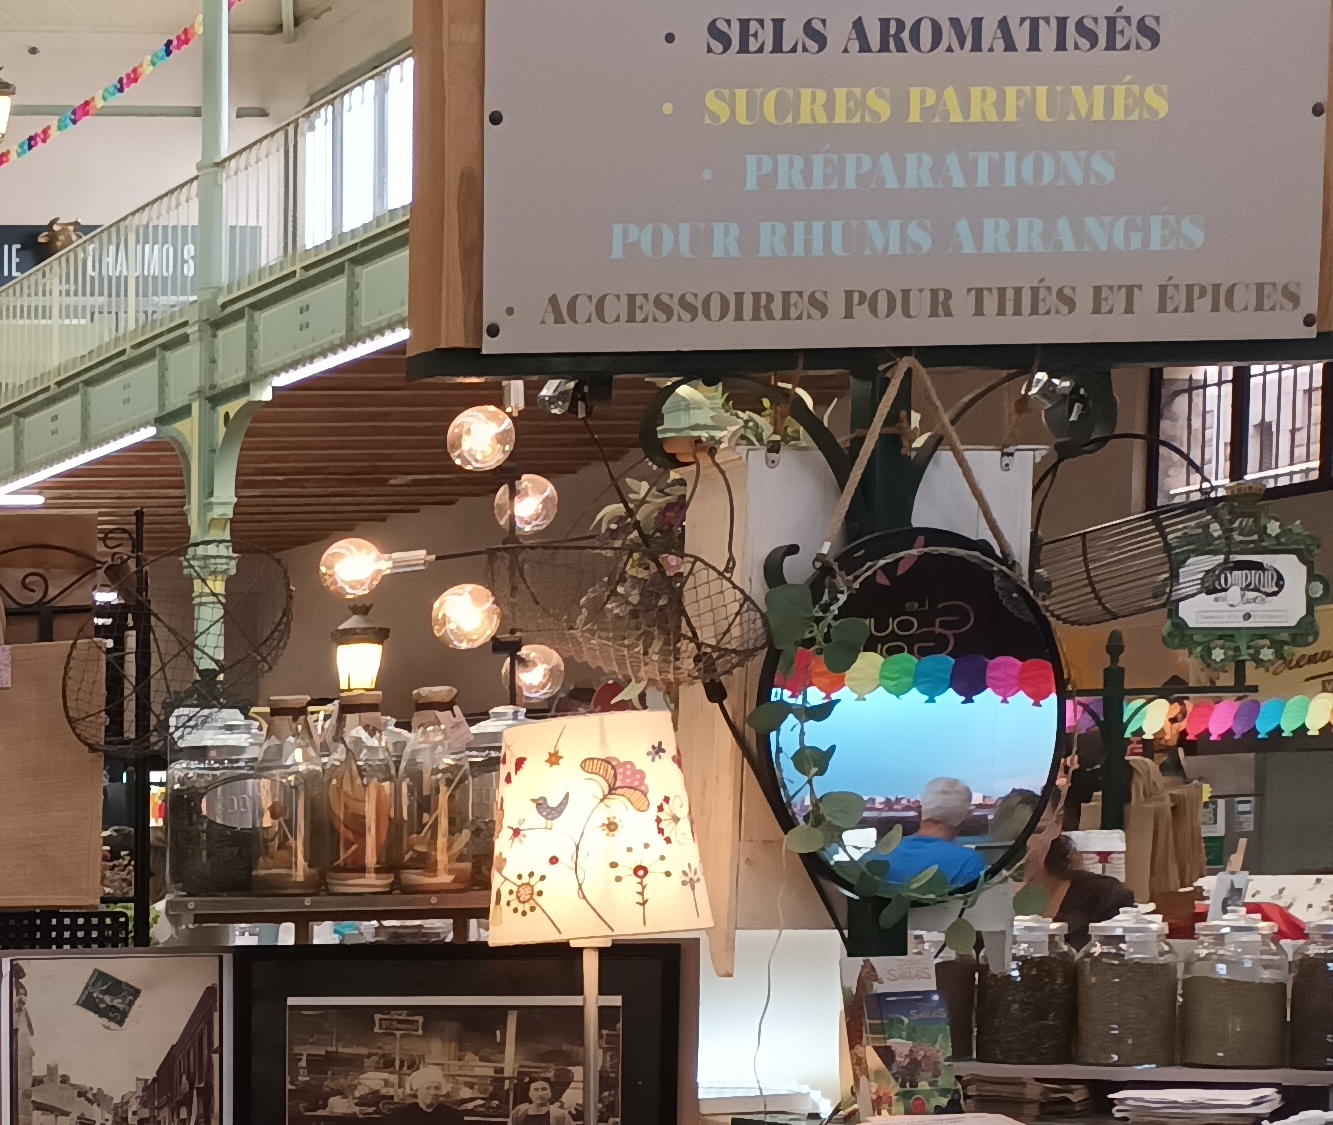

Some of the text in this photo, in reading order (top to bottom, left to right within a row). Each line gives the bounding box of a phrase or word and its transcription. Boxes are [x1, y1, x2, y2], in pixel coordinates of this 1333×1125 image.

[706, 5, 1162, 55] SELS AROMATISÉS
[704, 74, 1170, 126] SUCRES PARFUMÉS
[743, 143, 1117, 191] PRÉPARATIONS
[609, 204, 1206, 259] POUR RHUMS ARRANGÉS
[540, 275, 1302, 325] ACCESSOIRES POUR THÉS ET ÉPICES
